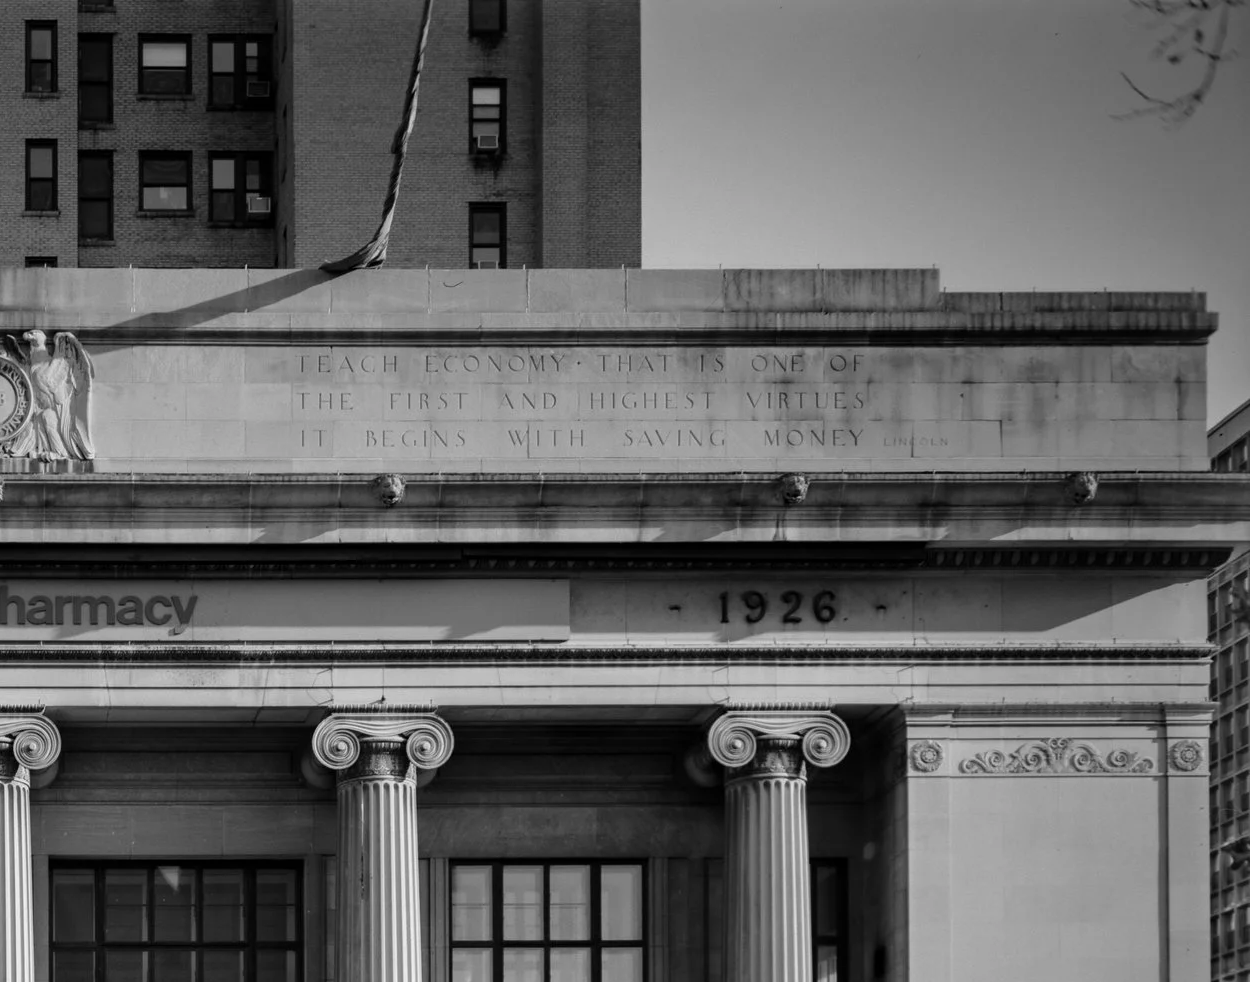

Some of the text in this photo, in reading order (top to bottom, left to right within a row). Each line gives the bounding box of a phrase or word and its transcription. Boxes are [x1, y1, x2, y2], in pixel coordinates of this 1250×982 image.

[295, 354, 398, 373] TEACH
[597, 354, 672, 373] THAT
[700, 354, 725, 373] IS
[751, 354, 804, 373] ONE
[829, 354, 865, 373] OF
[296, 392, 865, 410] THE FIRST AND HIGHEST VIRTUES
[301, 429, 865, 448] IT BEGINS WITH SAVING MONEY
[883, 437, 949, 447] LINCOLN
[718, 590, 837, 624] 1926
